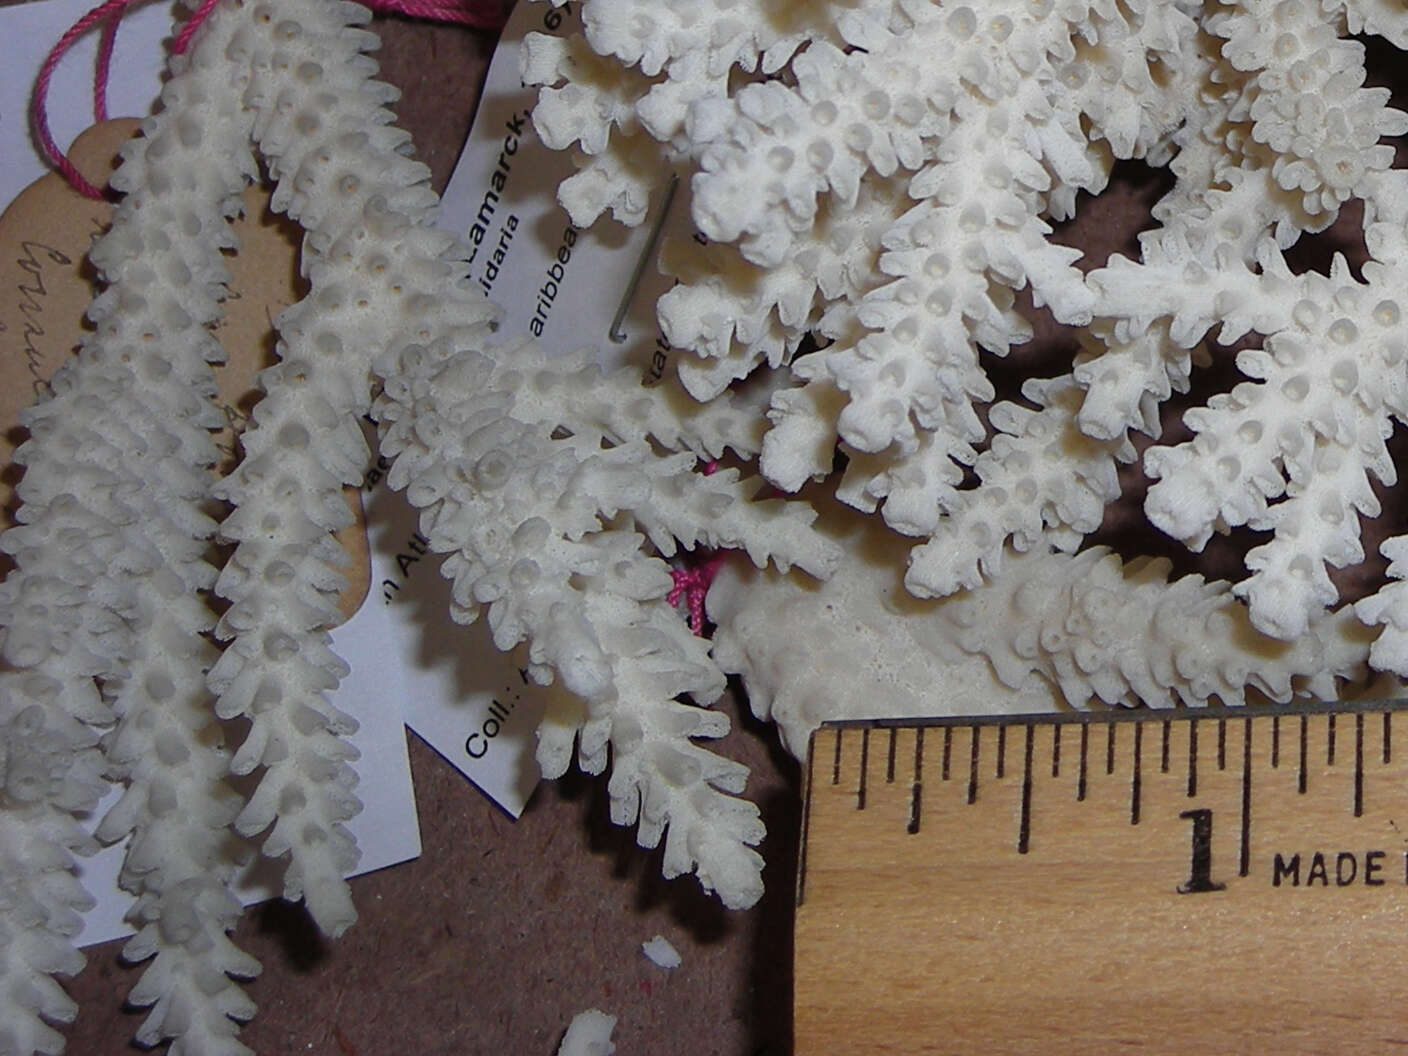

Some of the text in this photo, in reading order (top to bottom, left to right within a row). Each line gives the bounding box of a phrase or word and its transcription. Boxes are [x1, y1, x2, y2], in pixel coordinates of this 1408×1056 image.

[479, 213, 519, 297] idaria
[529, 225, 579, 338] aribbea
[1175, 808, 1227, 895] 1
[1272, 851, 1386, 887] MADE
